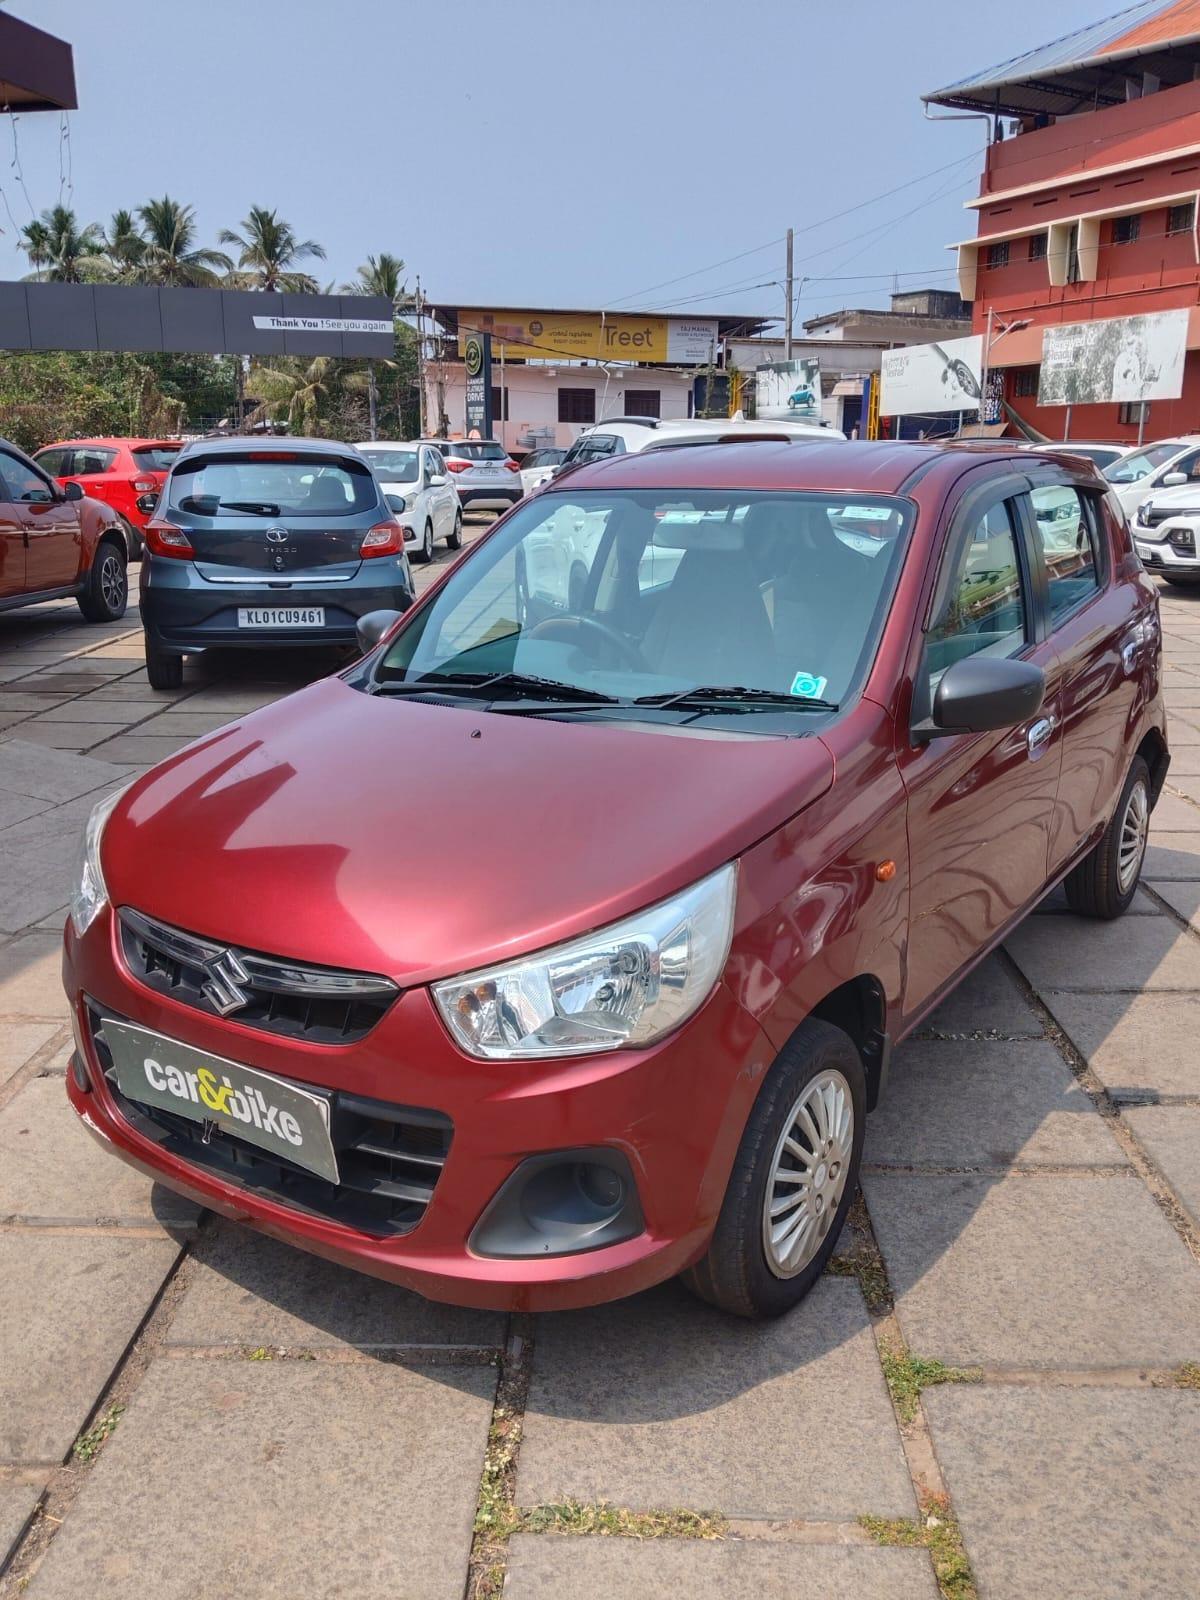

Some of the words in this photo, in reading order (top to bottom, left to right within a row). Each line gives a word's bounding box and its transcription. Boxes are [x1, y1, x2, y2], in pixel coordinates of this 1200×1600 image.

[270, 318, 299, 328] Thank
[302, 319, 318, 328] You
[344, 321, 361, 331] you
[362, 321, 386, 331] again
[599, 325, 654, 347] Treet
[467, 393, 485, 402] DRIVE
[246, 610, 322, 624] KL01CU9461
[143, 1059, 304, 1147] car&bike
